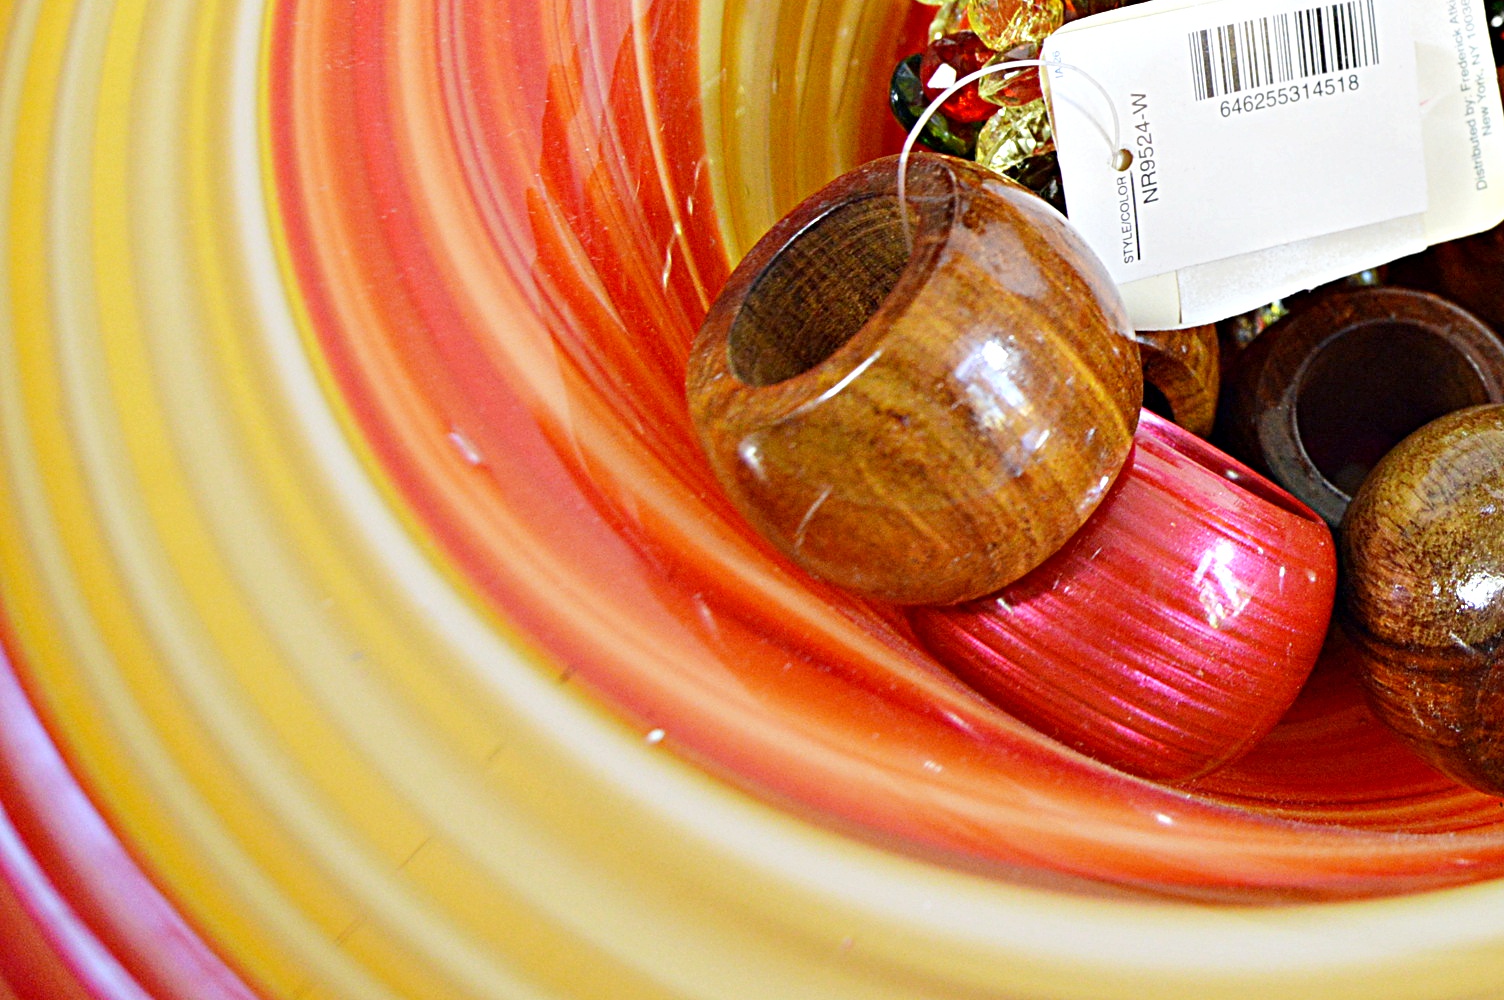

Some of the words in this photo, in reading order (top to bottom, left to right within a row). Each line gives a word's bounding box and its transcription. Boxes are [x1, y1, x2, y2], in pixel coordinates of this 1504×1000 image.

[1452, 28, 1471, 92] Frederick
[1468, 45, 1480, 65] NY
[1220, 74, 1359, 118] 646255314518
[1464, 96, 1476, 116] by:
[1481, 106, 1492, 137] New
[1130, 93, 1159, 204] NR9524-W
[1466, 119, 1488, 191] Distributed
[1117, 176, 1134, 264] STYLE/COLOR
